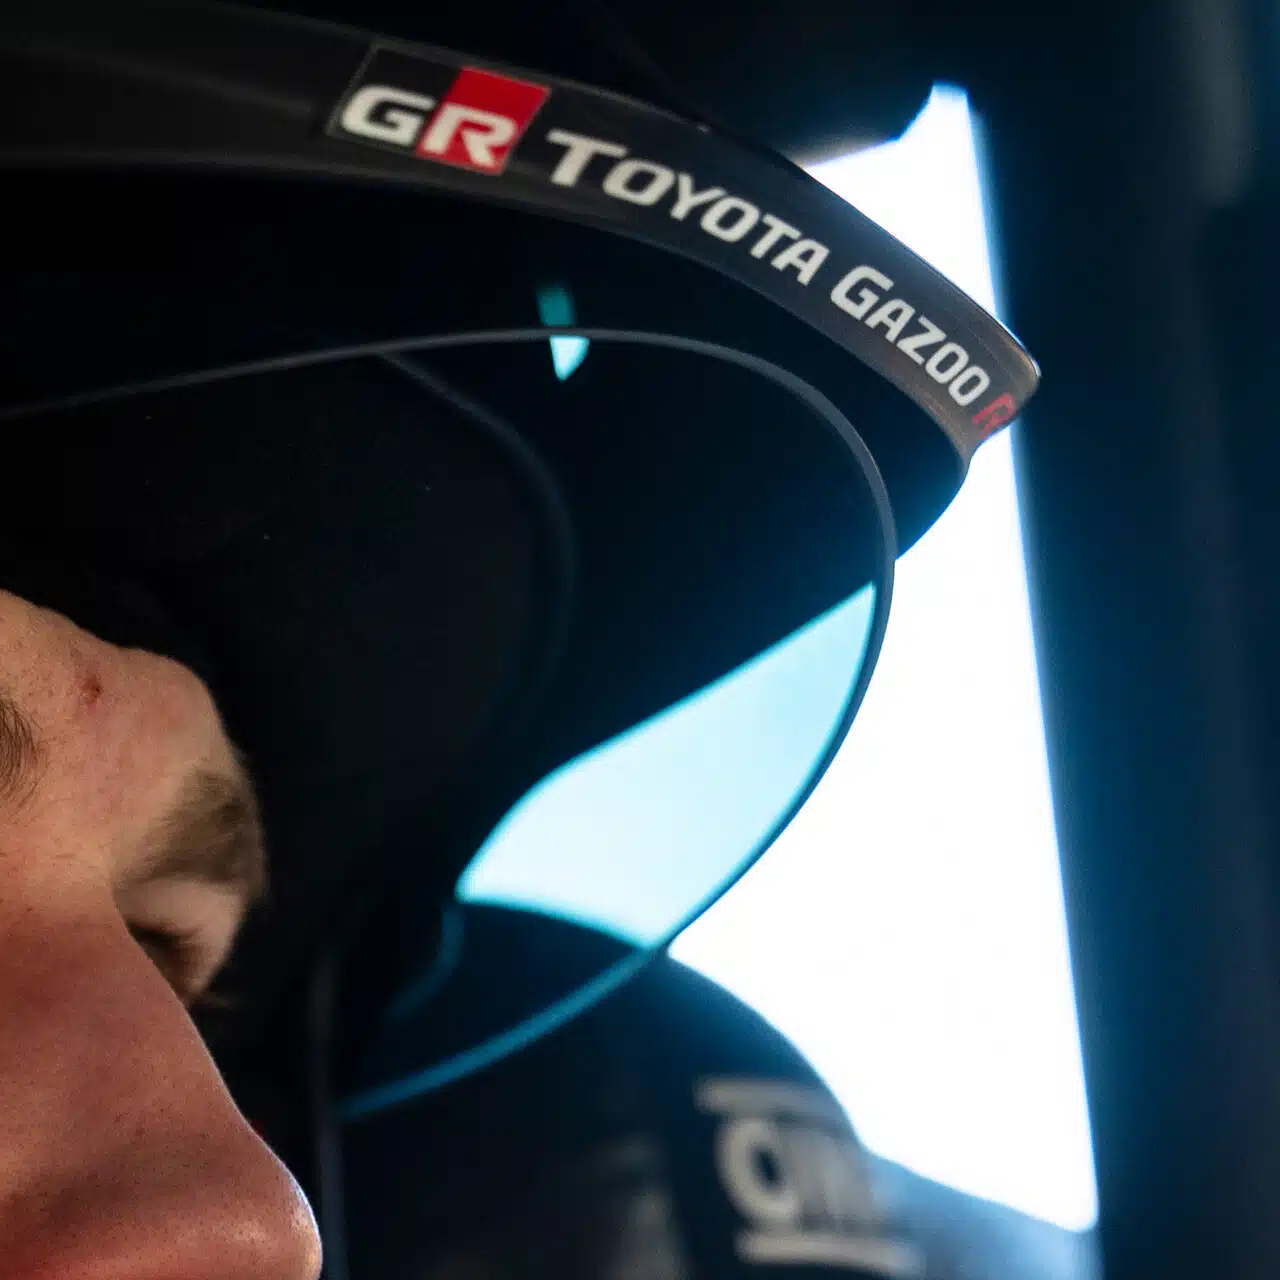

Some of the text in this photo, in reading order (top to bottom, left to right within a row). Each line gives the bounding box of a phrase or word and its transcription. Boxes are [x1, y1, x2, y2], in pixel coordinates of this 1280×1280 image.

[341, 84, 519, 169] GR
[546, 129, 830, 287] TOYOTA
[830, 264, 991, 407] GAZOO
